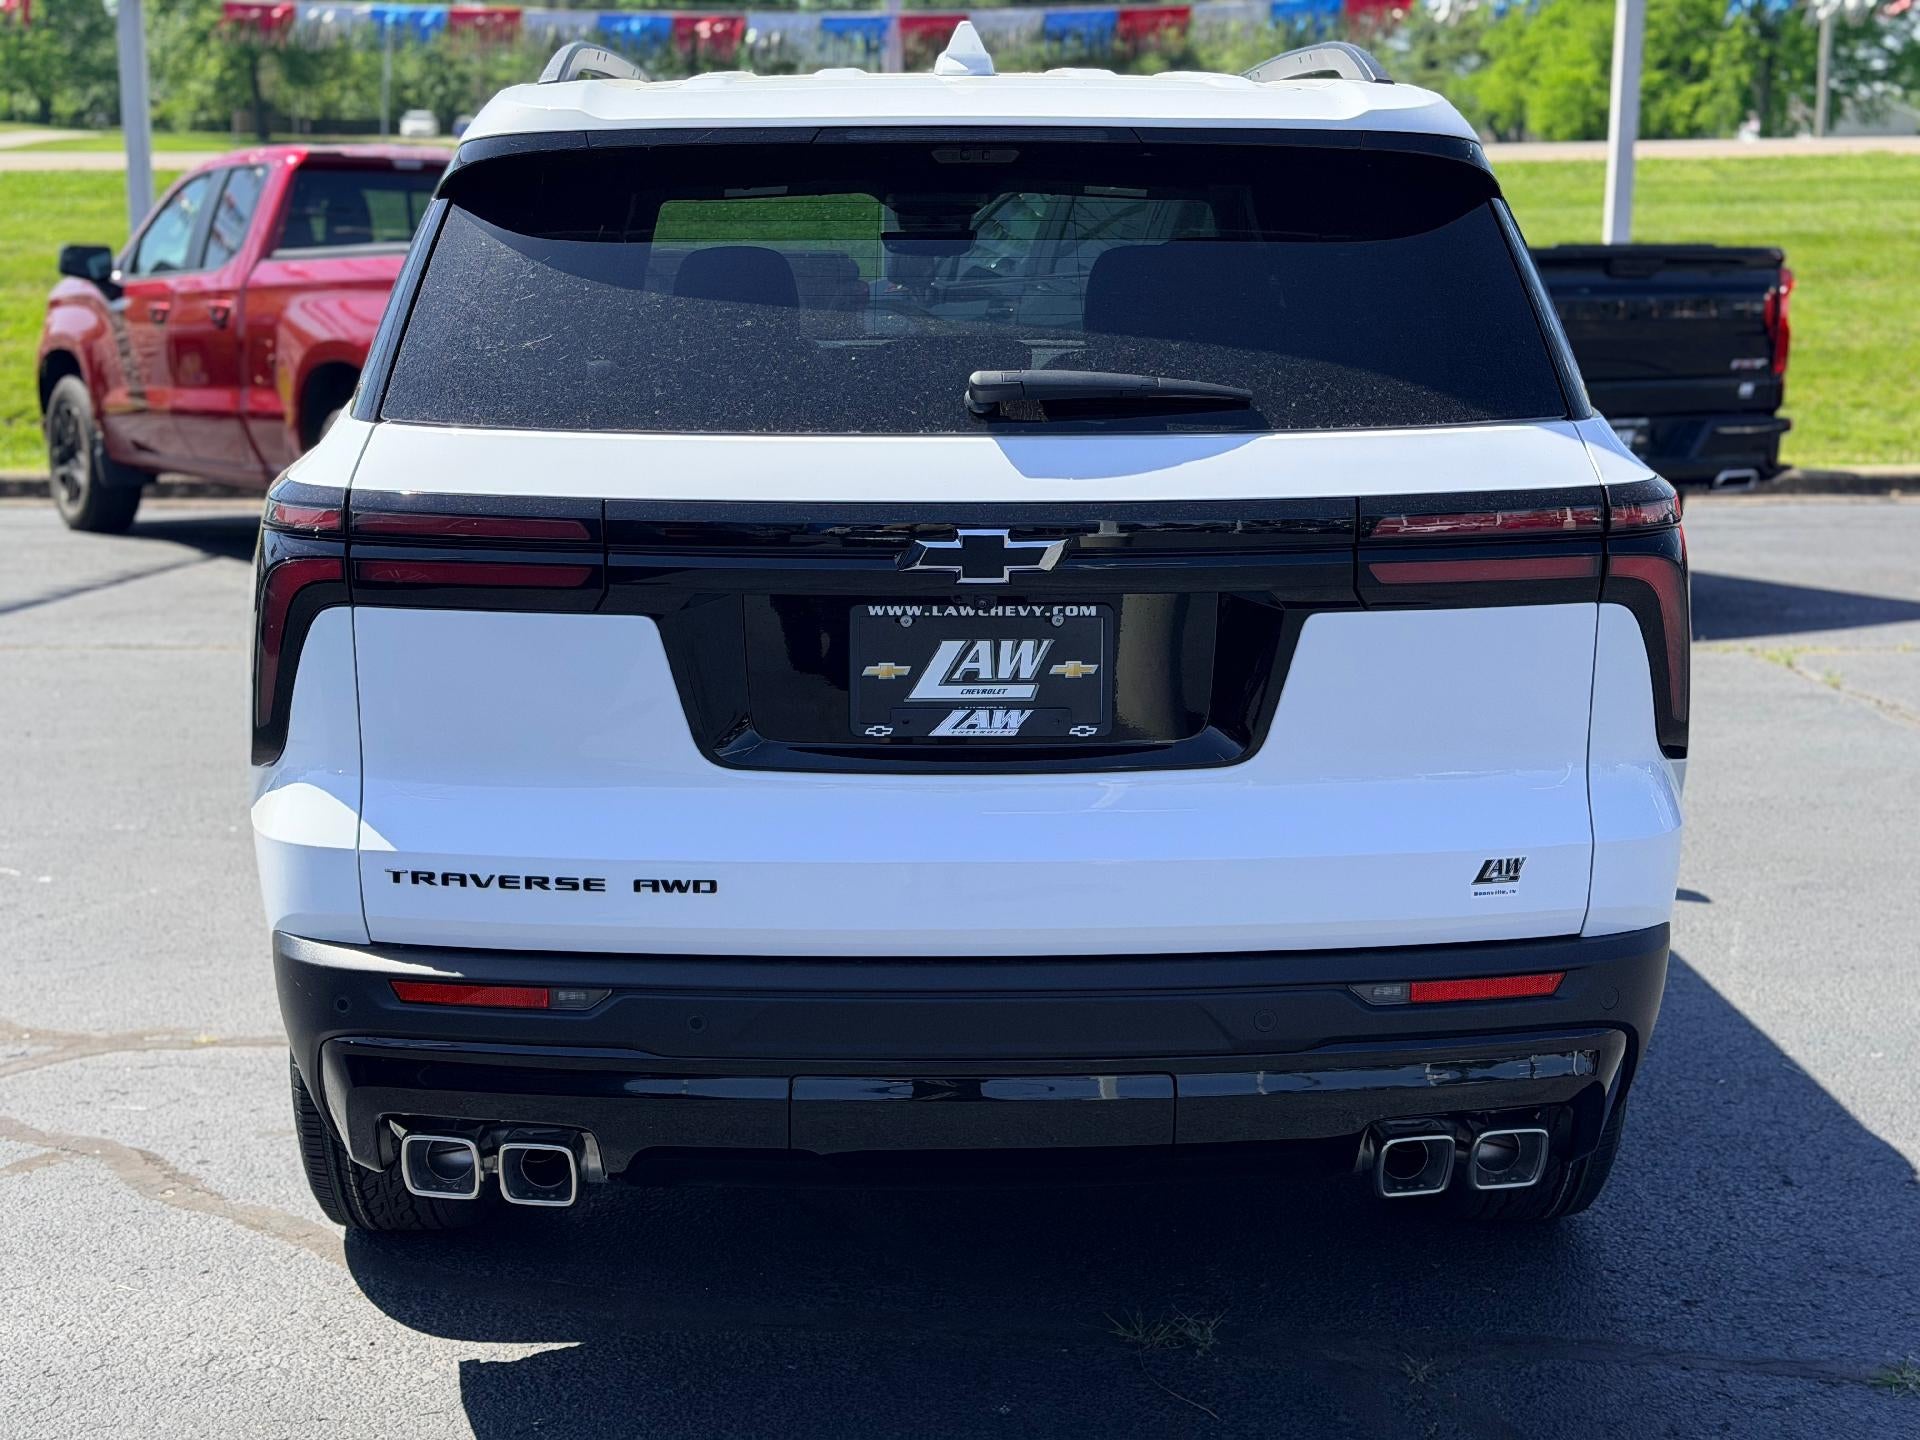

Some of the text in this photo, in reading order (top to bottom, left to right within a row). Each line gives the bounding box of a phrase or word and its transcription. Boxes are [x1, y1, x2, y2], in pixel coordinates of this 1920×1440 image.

[904, 639, 1054, 702] LAW
[928, 709, 1034, 736] LAW
[384, 868, 718, 894] TRAVERSE AWD
[1471, 857, 1527, 885] LAW
